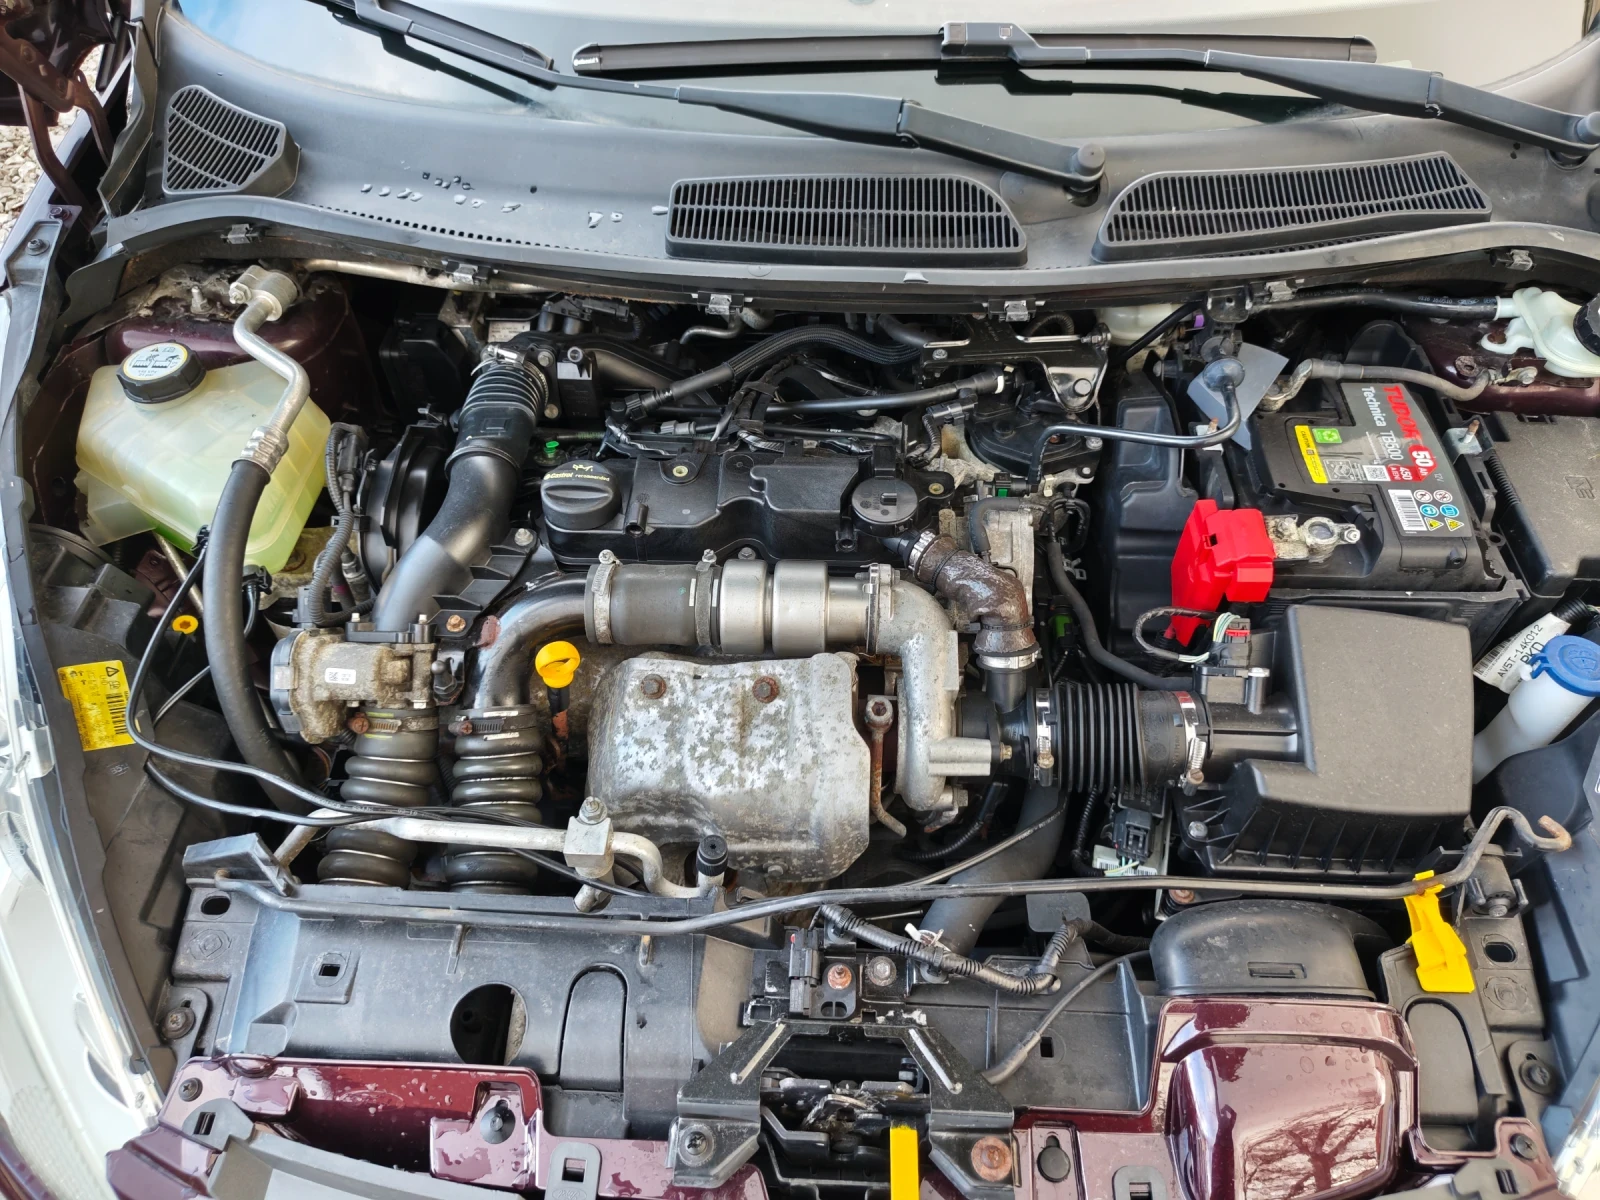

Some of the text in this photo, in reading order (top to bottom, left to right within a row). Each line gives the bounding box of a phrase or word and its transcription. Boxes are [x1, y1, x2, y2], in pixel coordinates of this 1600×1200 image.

[1361, 386, 1387, 427] Technica
[1380, 430, 1404, 460] TB500
[1383, 385, 1423, 446] TUDOR
[1400, 466, 1413, 480] 450
[1411, 450, 1434, 467] 50
[1497, 624, 1544, 678] AV5T-14K012
